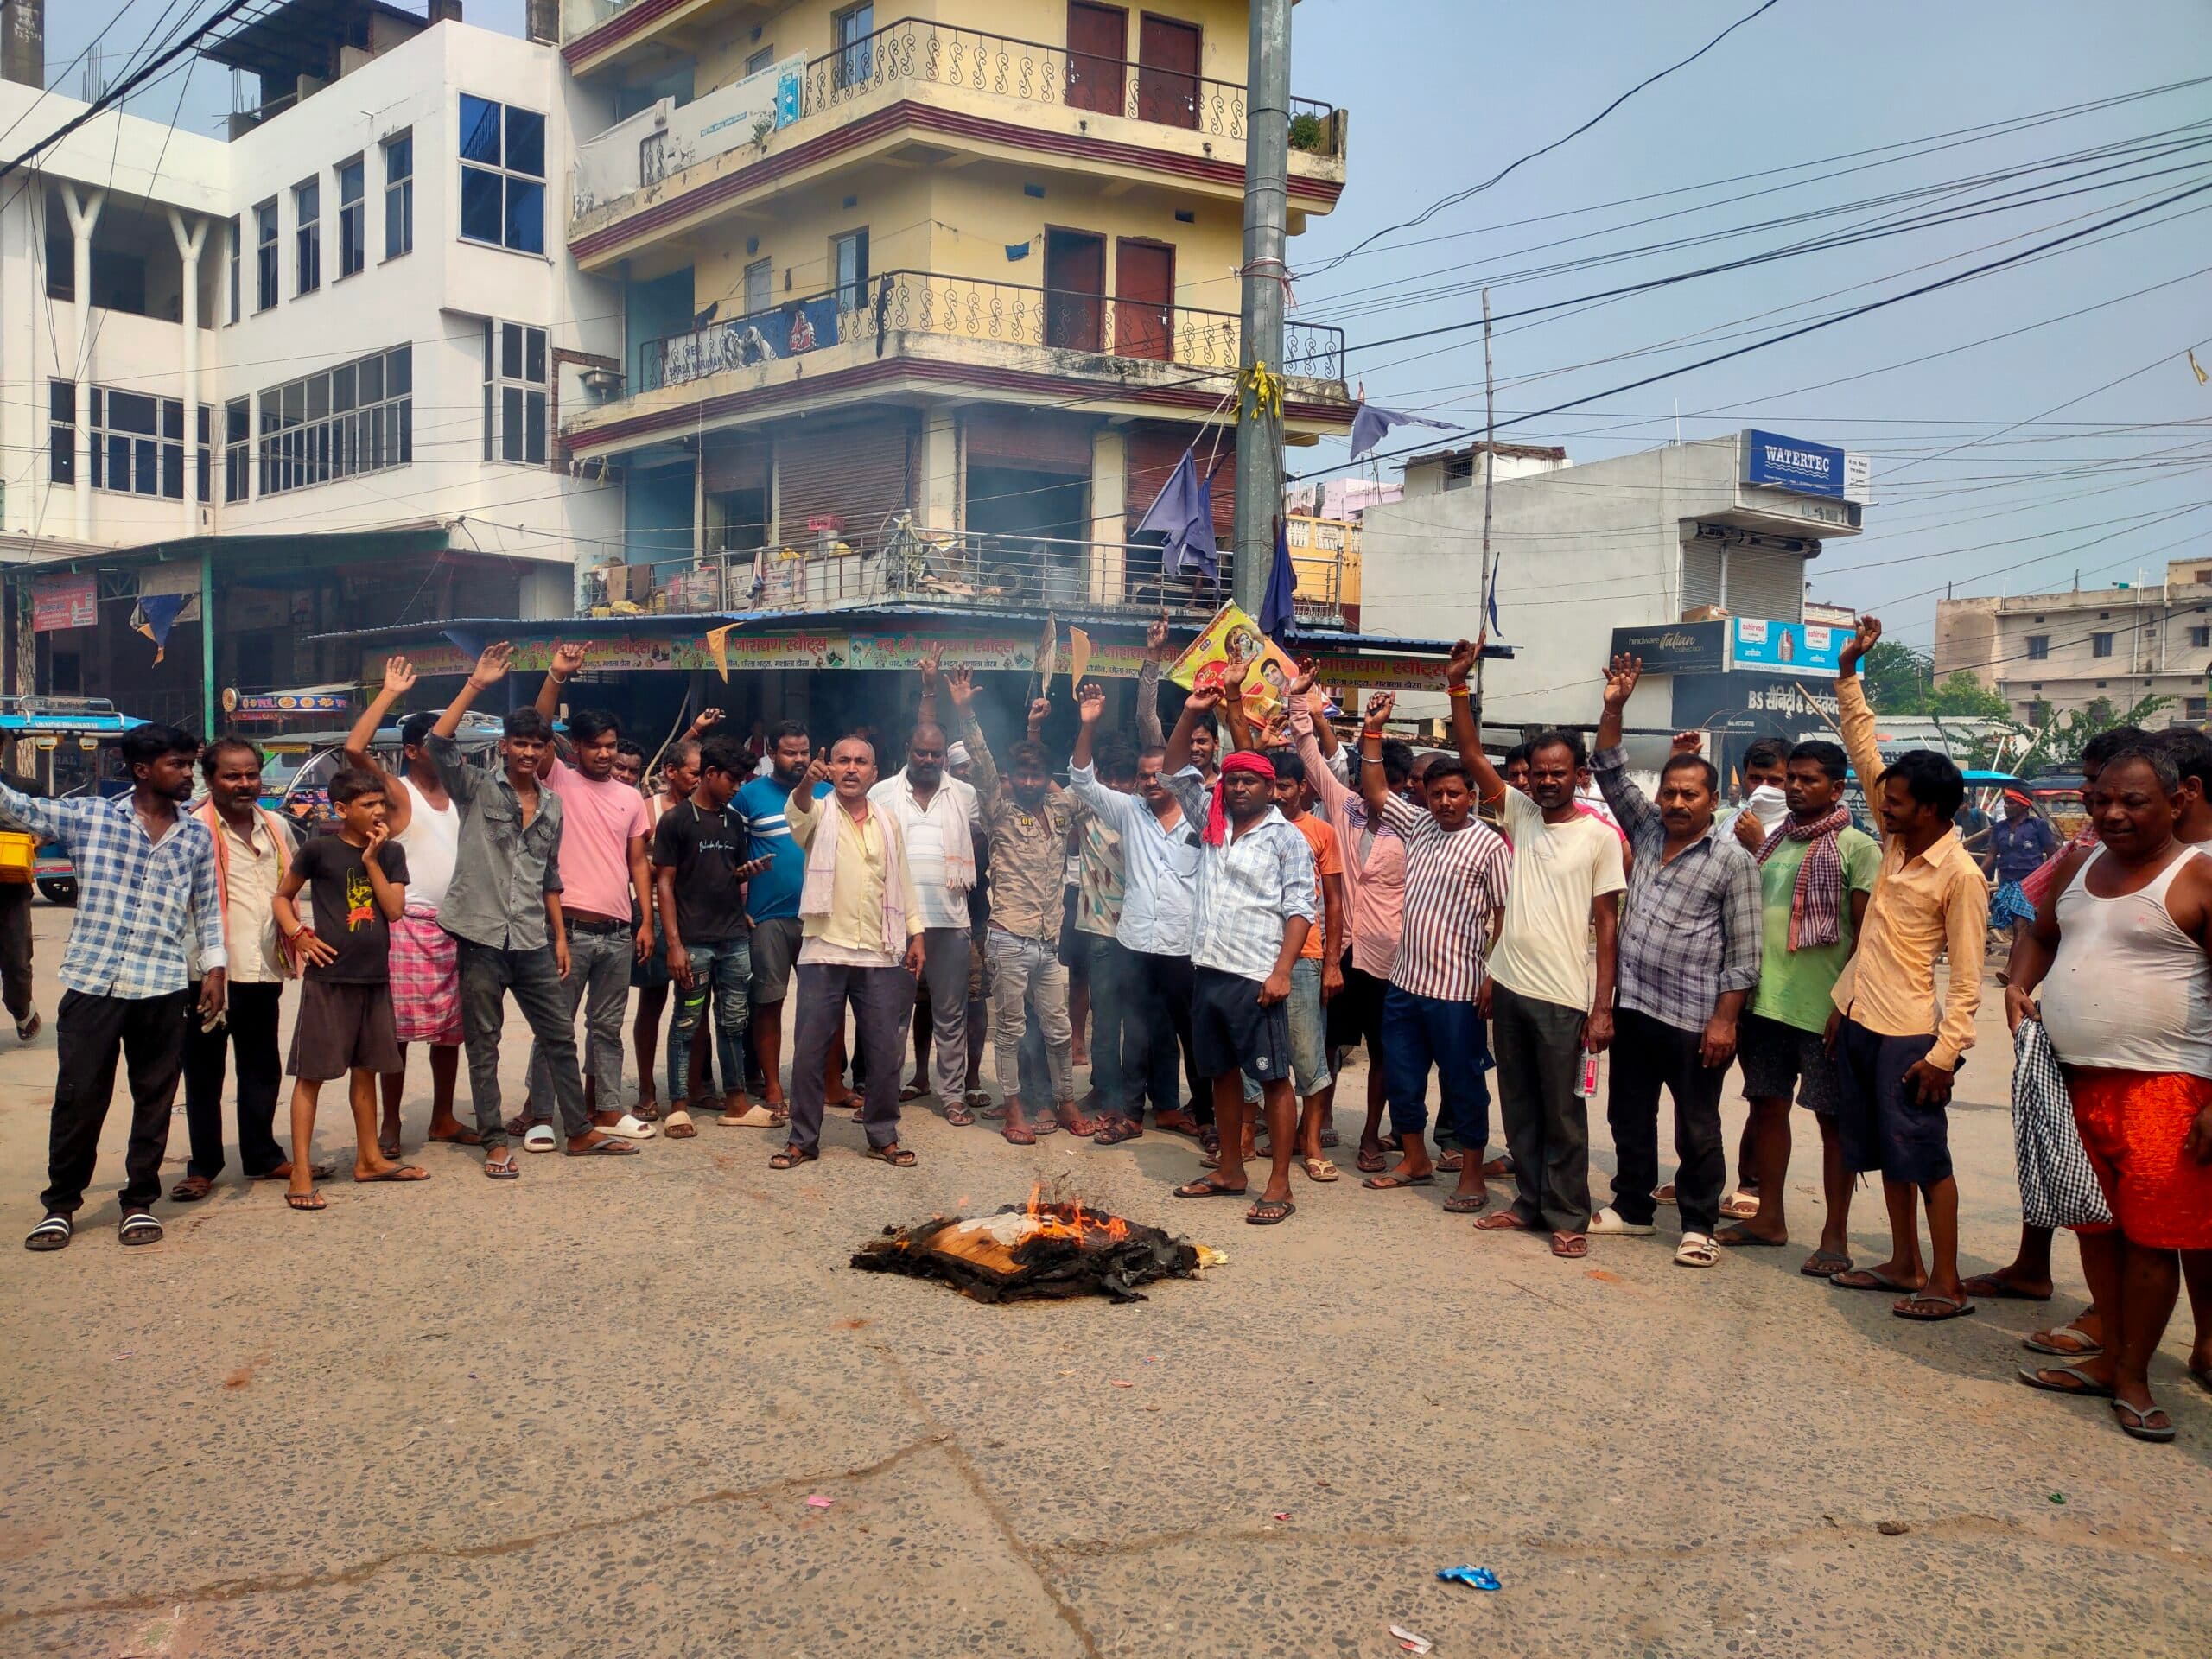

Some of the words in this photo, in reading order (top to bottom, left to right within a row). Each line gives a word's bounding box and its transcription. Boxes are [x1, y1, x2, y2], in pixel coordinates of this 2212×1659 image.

[1764, 445, 1830, 473] WATERTEC
[1742, 623, 1765, 632] ashirvad
[1808, 630, 1828, 639] ashirvad
[734, 637, 782, 652] नारायण
[785, 631, 828, 657] स्वीट्स
[1628, 636, 1659, 645] hindware
[1659, 631, 1696, 650] italian
[1748, 690, 1764, 709] BS
[1796, 694, 1804, 713] &
